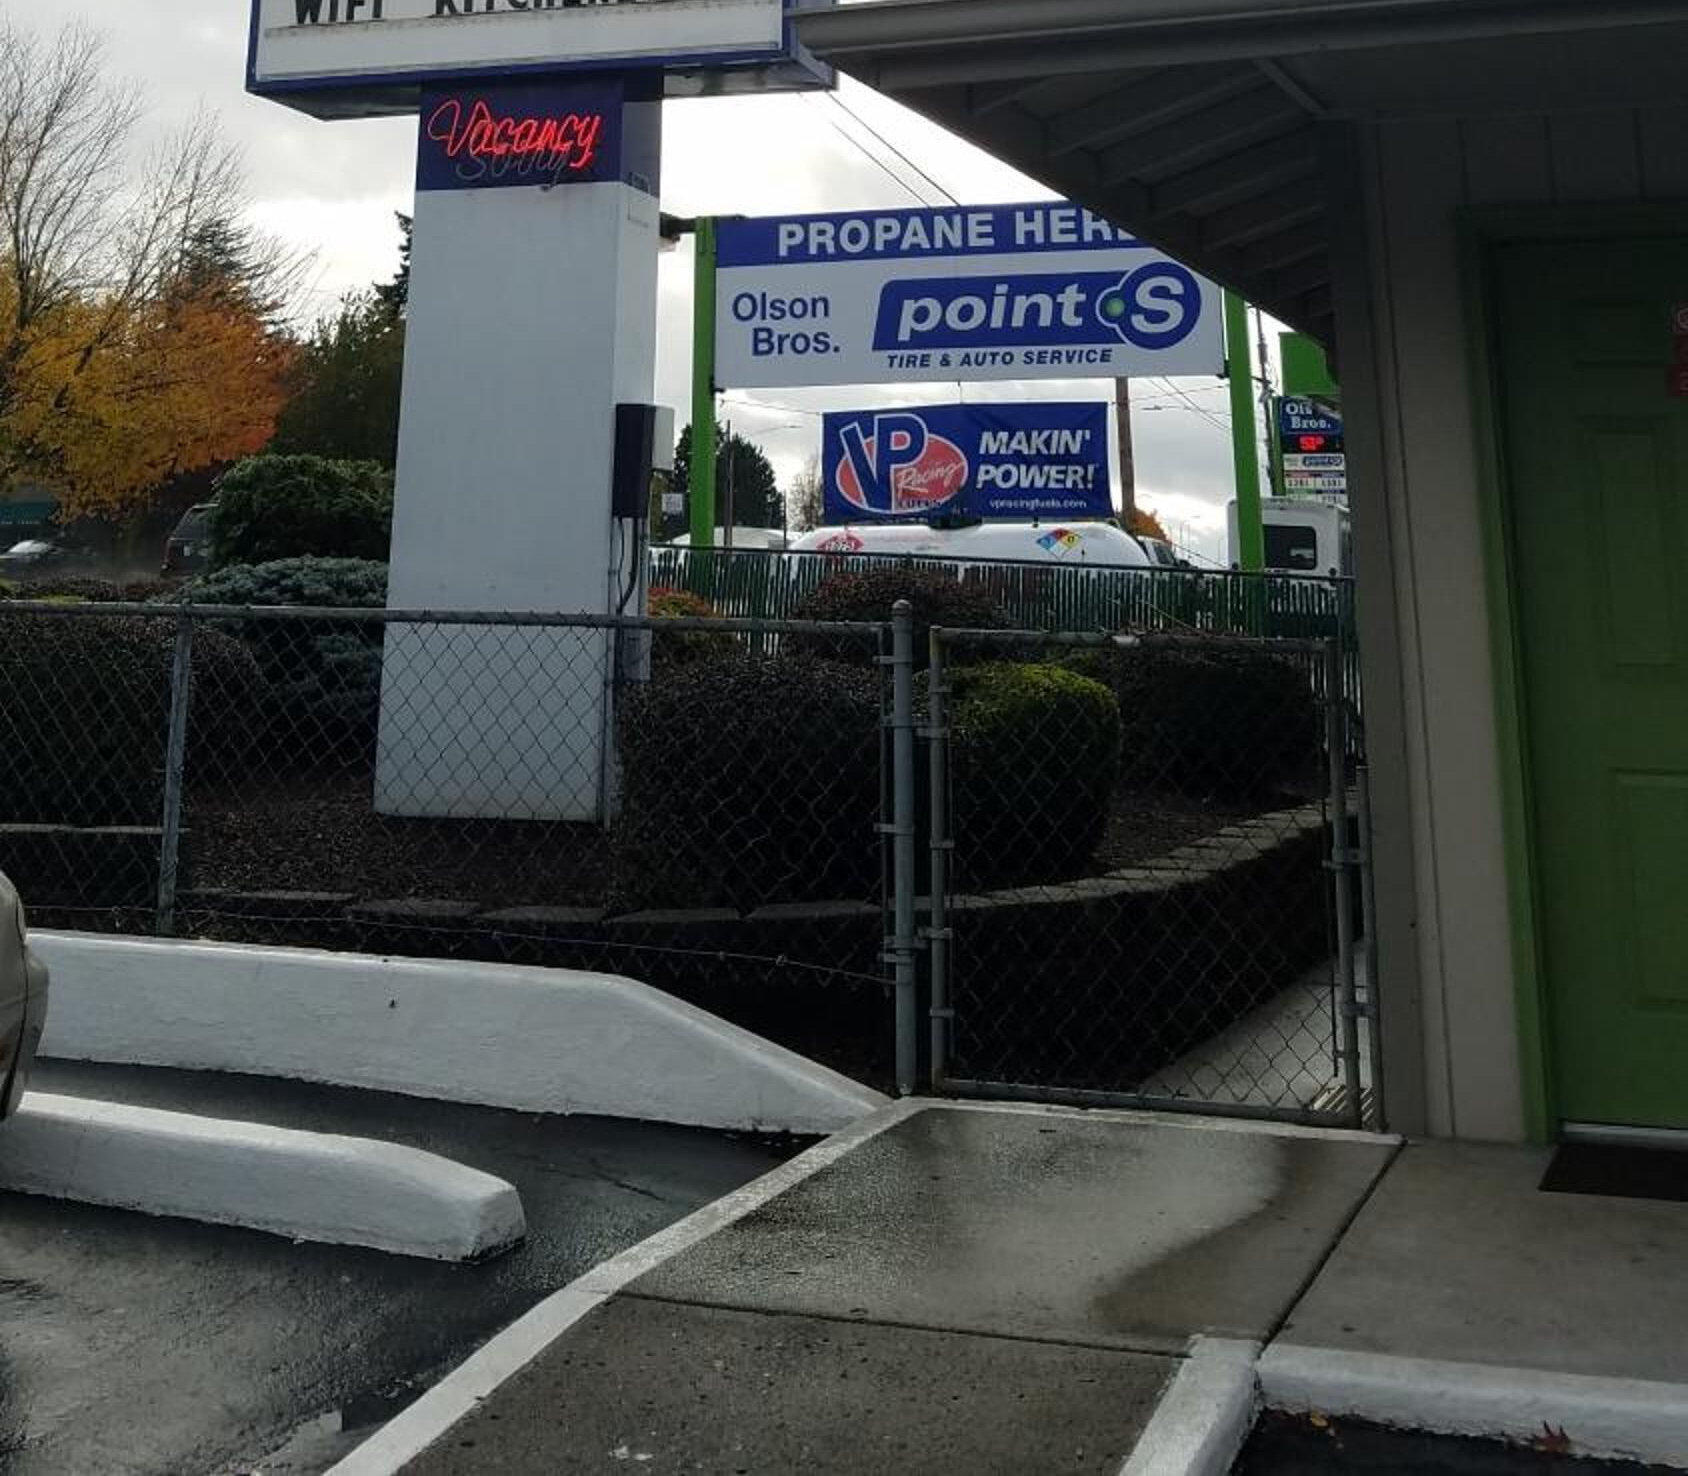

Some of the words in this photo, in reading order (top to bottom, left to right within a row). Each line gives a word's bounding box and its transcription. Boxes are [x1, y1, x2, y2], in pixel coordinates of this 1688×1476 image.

[427, 100, 601, 168] Vacancy
[778, 213, 995, 257] PROPANE
[1015, 208, 1137, 245] HER
[732, 291, 830, 322] Olson
[897, 283, 1085, 342] point
[752, 325, 841, 356] Bros.
[887, 354, 931, 370] TIRE
[939, 353, 951, 367] &
[959, 351, 1015, 368] AUTO
[1023, 348, 1113, 366] SERVICE
[979, 429, 1091, 455] MAKIN'
[839, 413, 929, 514] VP
[897, 460, 964, 497] Racing
[976, 463, 1095, 490] POWER!
[989, 498, 1087, 510] vpracingfuels.com
